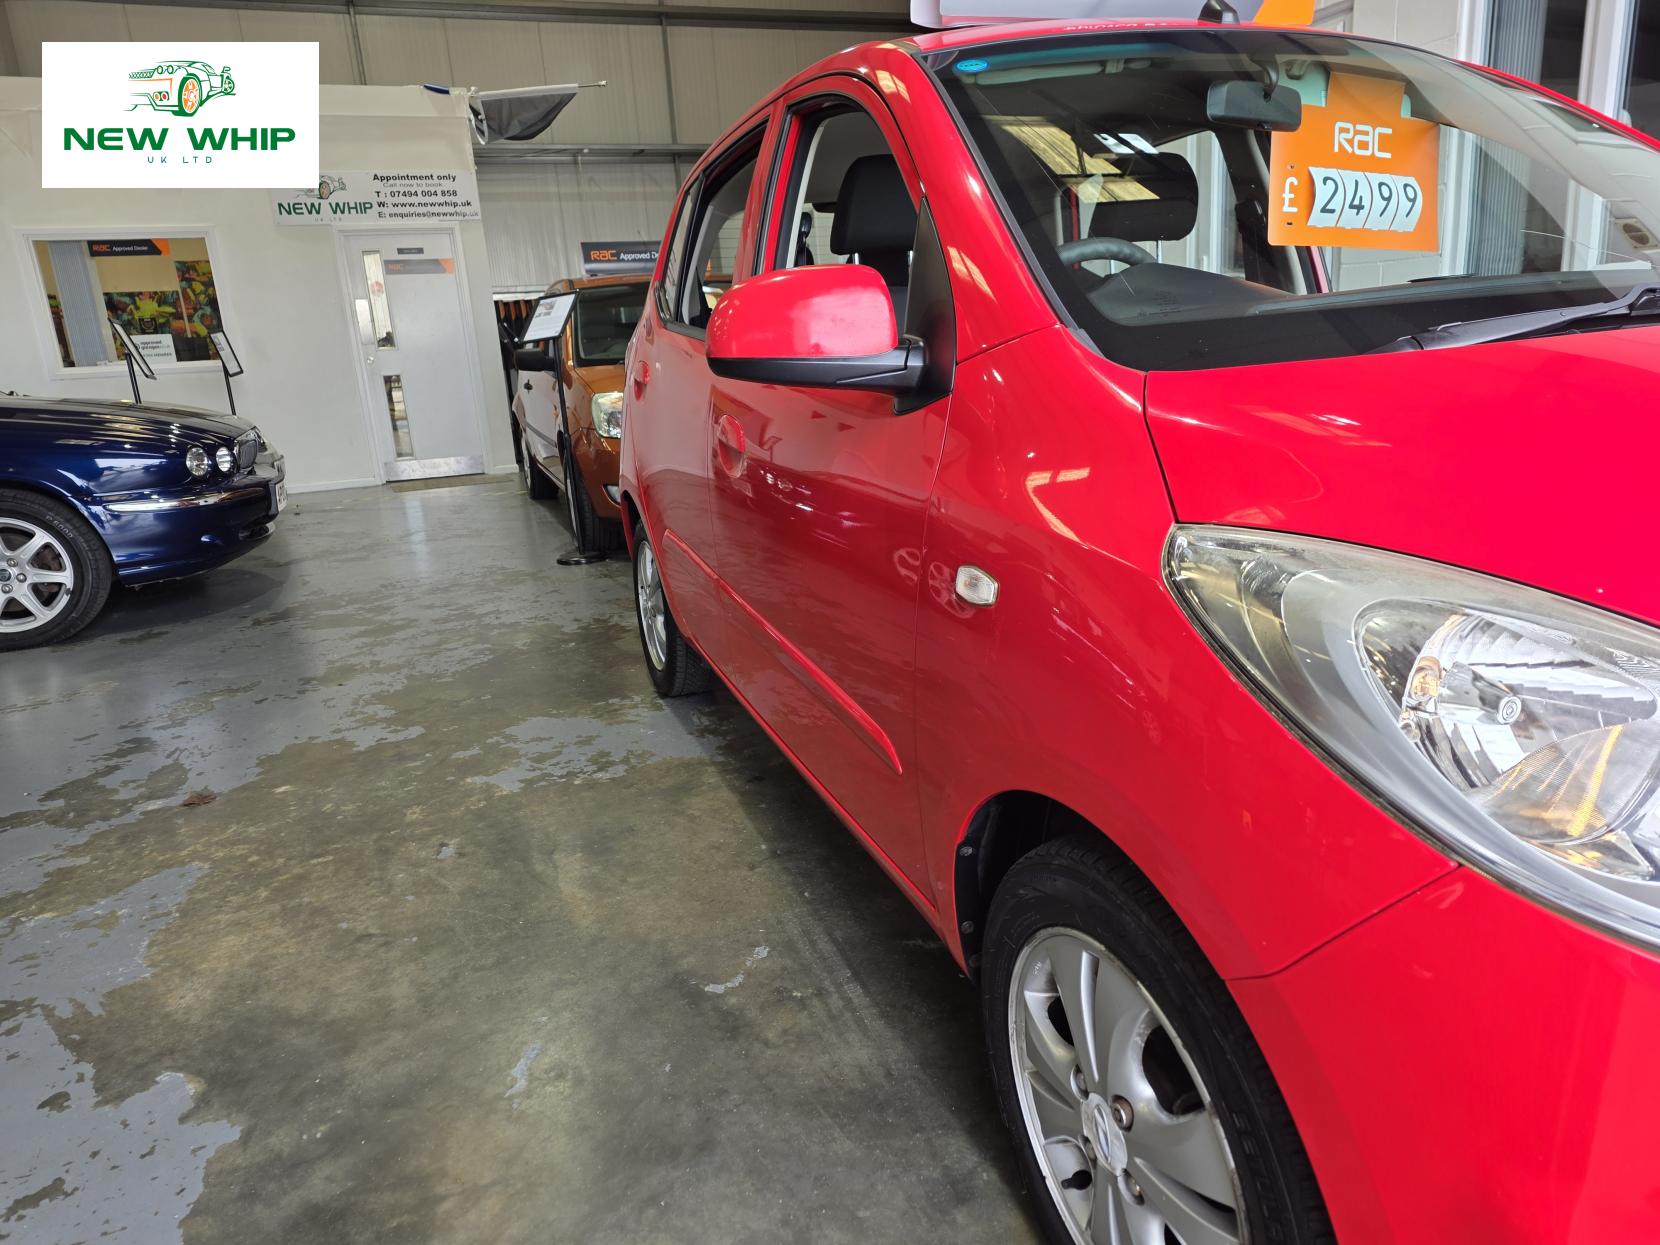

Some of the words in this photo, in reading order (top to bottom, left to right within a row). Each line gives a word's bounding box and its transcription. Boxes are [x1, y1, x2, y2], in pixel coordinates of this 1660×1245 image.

[373, 174, 434, 182] Appointment
[437, 174, 457, 182] only
[390, 190, 418, 198] 07494
[421, 190, 438, 198] 004
[1282, 176, 1298, 213] £
[1319, 176, 1418, 219] 2499
[278, 202, 321, 216] NEW
[329, 201, 374, 215] WHIP
[391, 200, 472, 209] www.newwhip.uk
[112, 245, 133, 253] Approved
[619, 251, 650, 261] Approved
